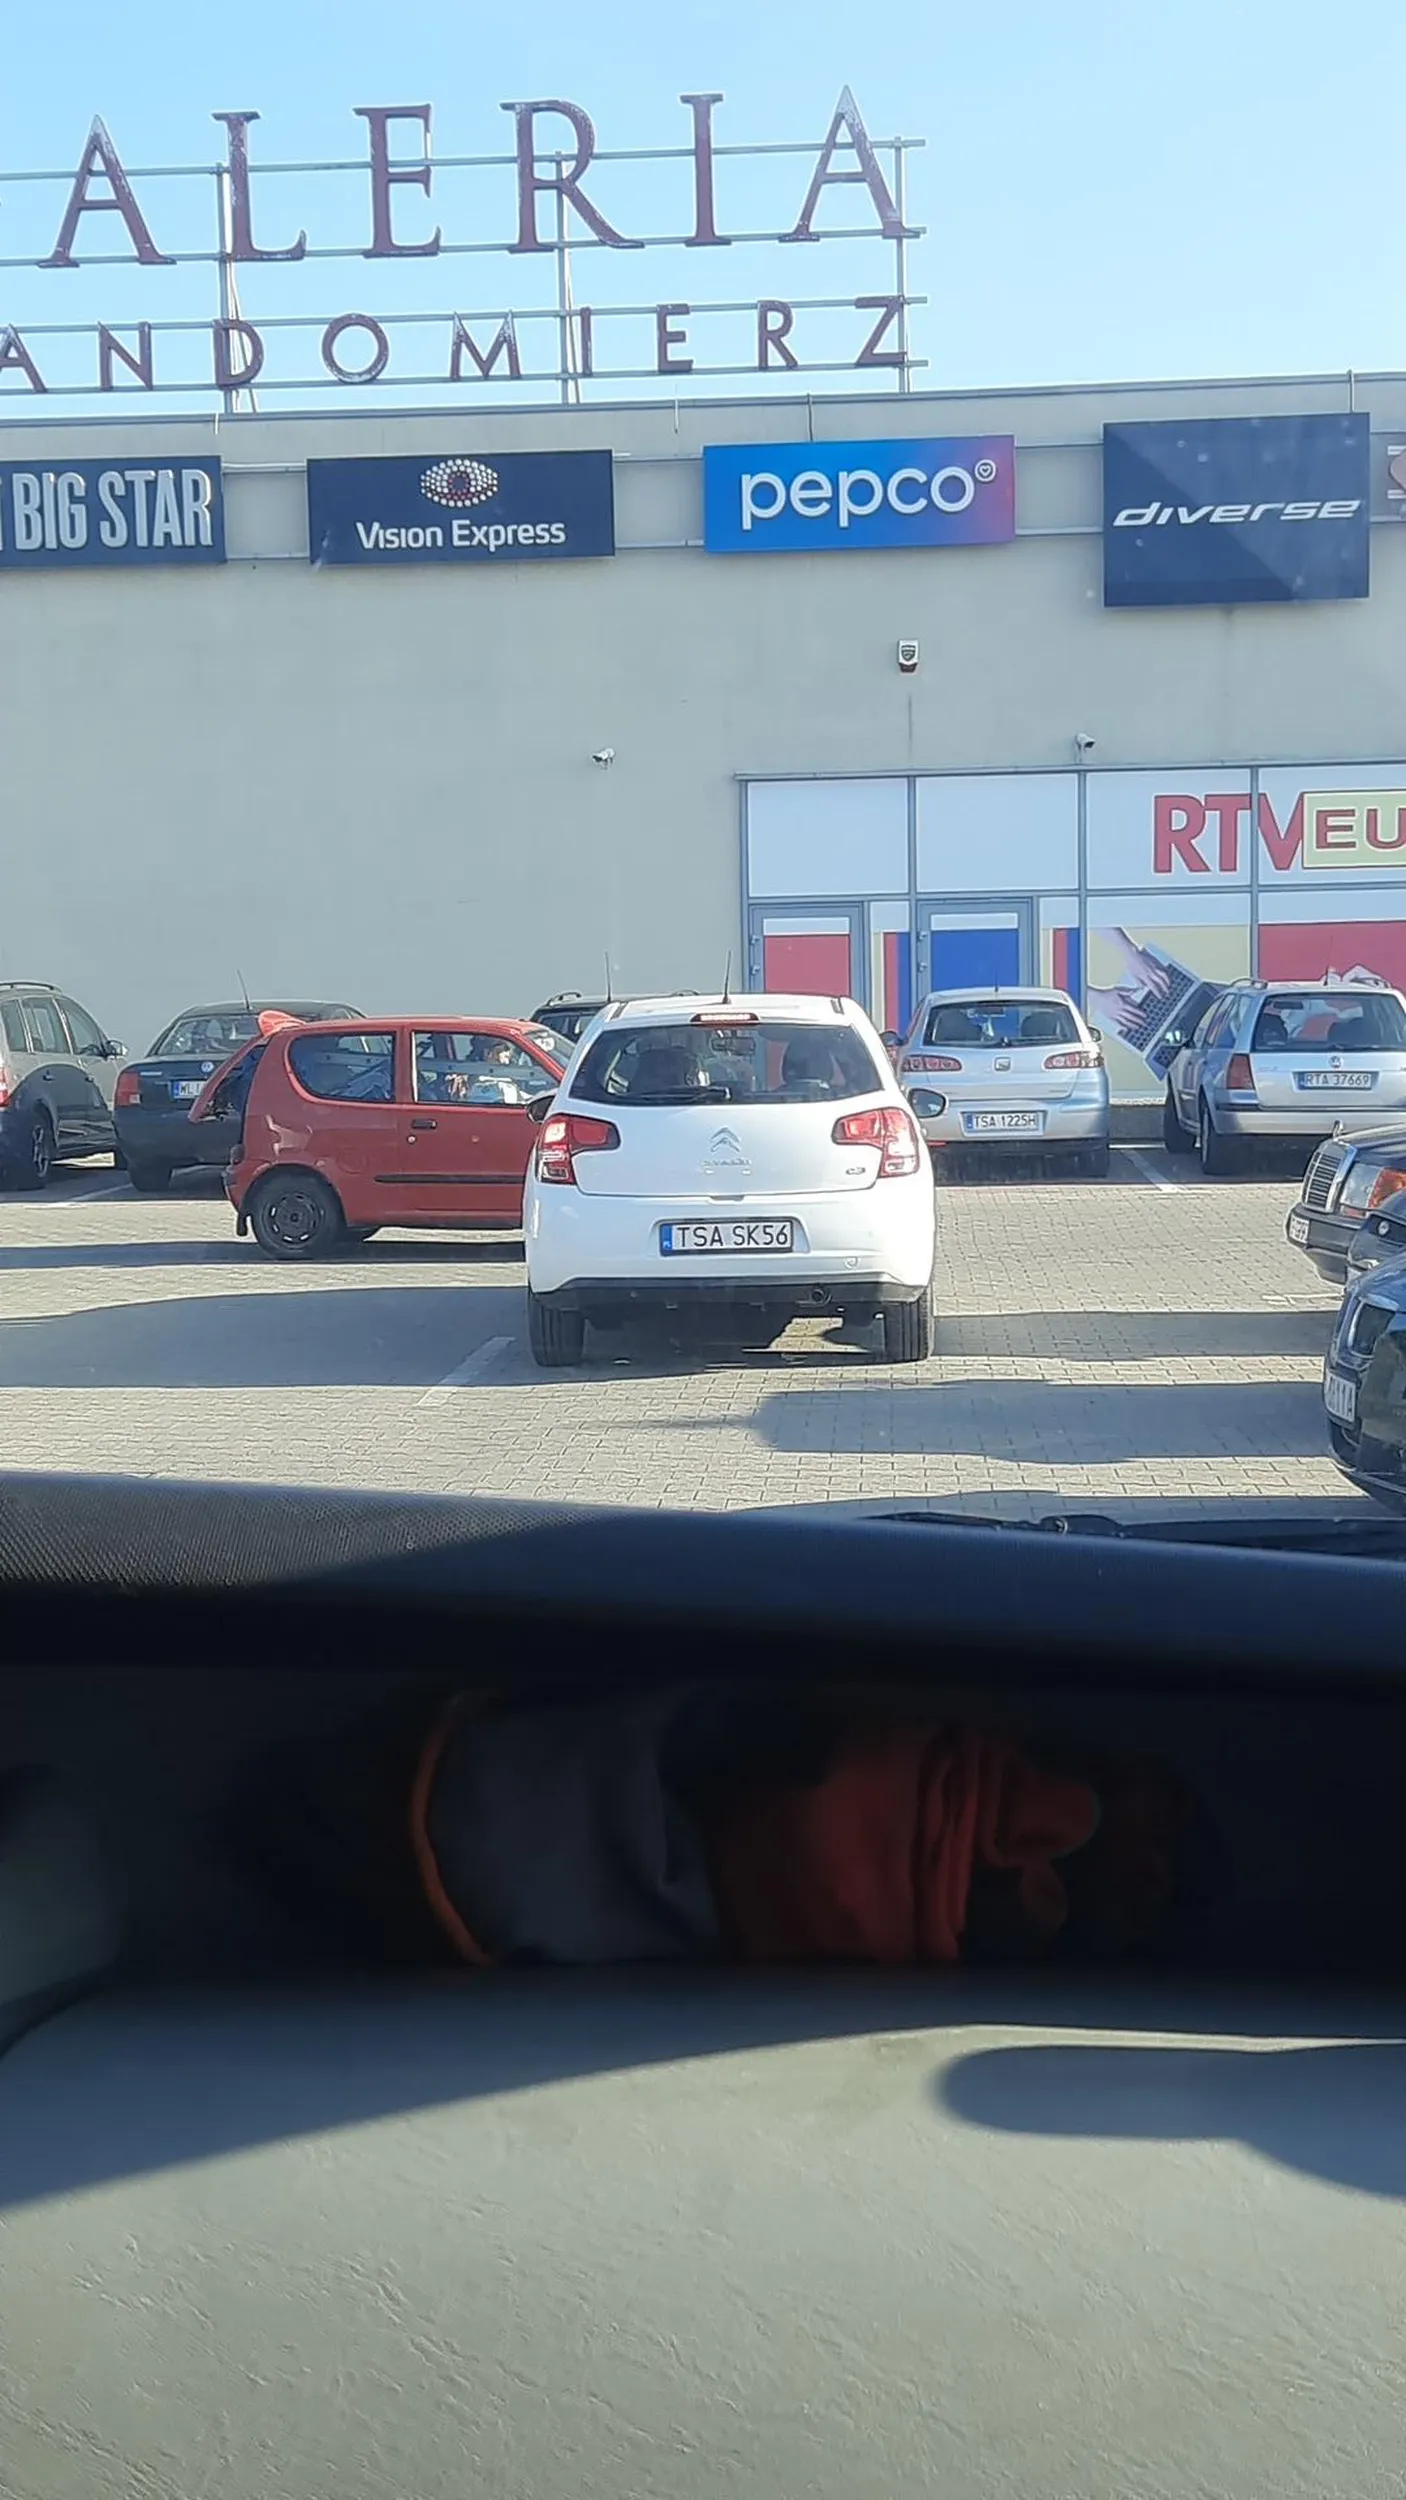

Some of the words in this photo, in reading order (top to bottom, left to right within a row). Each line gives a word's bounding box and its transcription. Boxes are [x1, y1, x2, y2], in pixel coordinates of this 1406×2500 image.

[0, 294, 907, 393] ANDOMIERZ
[12, 472, 88, 550] BIG
[98, 469, 213, 548] STAR
[741, 466, 975, 530] pepco
[1112, 500, 1361, 526] diverse
[355, 521, 443, 549] Vision
[451, 519, 566, 552] Express
[1154, 792, 1303, 873] RTV
[677, 1226, 724, 1247] TSA
[732, 1224, 788, 1246] SK56
